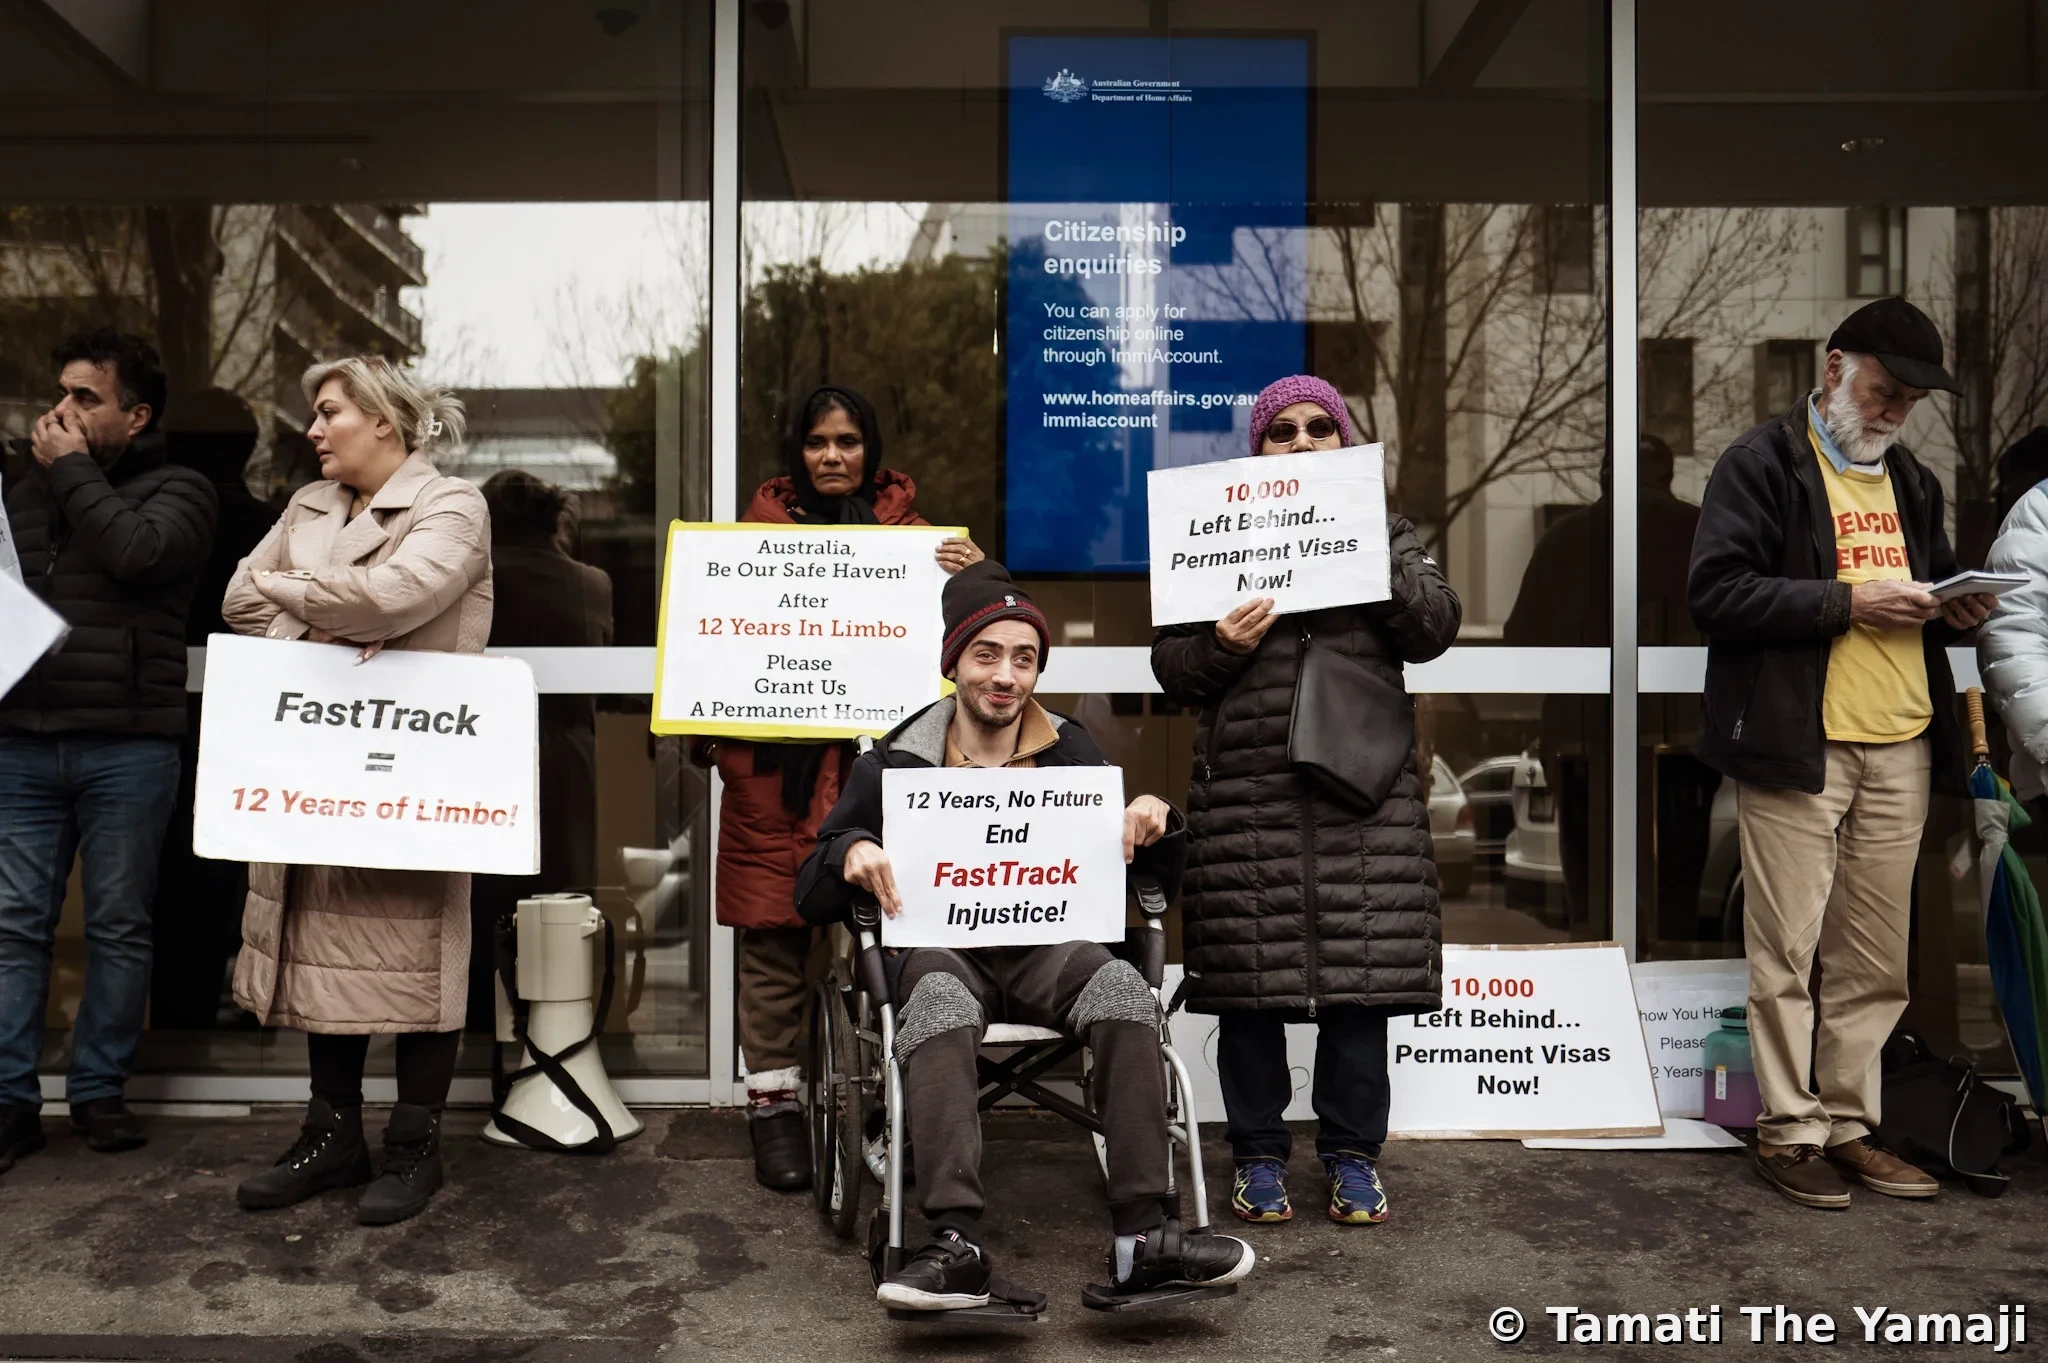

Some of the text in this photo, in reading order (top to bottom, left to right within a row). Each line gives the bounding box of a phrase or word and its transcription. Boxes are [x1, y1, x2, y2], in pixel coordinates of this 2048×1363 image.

[1092, 79, 1131, 87] Australian
[1092, 94, 1192, 103] Department of Home Affairs
[1044, 221, 1186, 247] Citizenship
[1044, 255, 1162, 279] enquiries
[1044, 303, 1186, 323] You can apply for
[1043, 326, 1184, 344] citizenship online
[1043, 348, 1223, 366] through ImmiAccount.
[1043, 391, 1257, 410] www.homeaffairs.gov.au
[1043, 413, 1157, 428] immiaccount
[1225, 479, 1300, 504] 10,000
[1190, 505, 1335, 537] Left Behind...
[1833, 510, 1902, 535] ELCO
[757, 540, 856, 557] Australia,
[1171, 538, 1358, 571] Permanent Visas
[1836, 545, 1908, 569] EFUG
[706, 562, 906, 580] Be Our Safe Haven!
[1237, 570, 1292, 592] Now!
[778, 593, 829, 608] After
[698, 618, 907, 638] 12 Years In Limbo
[767, 655, 832, 670] Please
[754, 679, 846, 695] Grant Us
[274, 691, 479, 736] FastTrack
[690, 702, 904, 721] A Permanent Home!
[232, 787, 518, 827] 12 Years of Limbo!
[906, 790, 1103, 811] 12 Years, No Future
[986, 823, 1029, 844] End
[934, 859, 1079, 887] FastTrack
[947, 900, 1067, 930] Injustice!
[1451, 977, 1534, 1000] 10,000
[1413, 1008, 1580, 1029] Left Behind...
[1640, 1007, 1723, 1022] how You Ha
[1395, 1043, 1611, 1064] Permanent Visas
[1652, 1066, 1702, 1078] 2 Years
[1478, 1075, 1539, 1095] Now!
